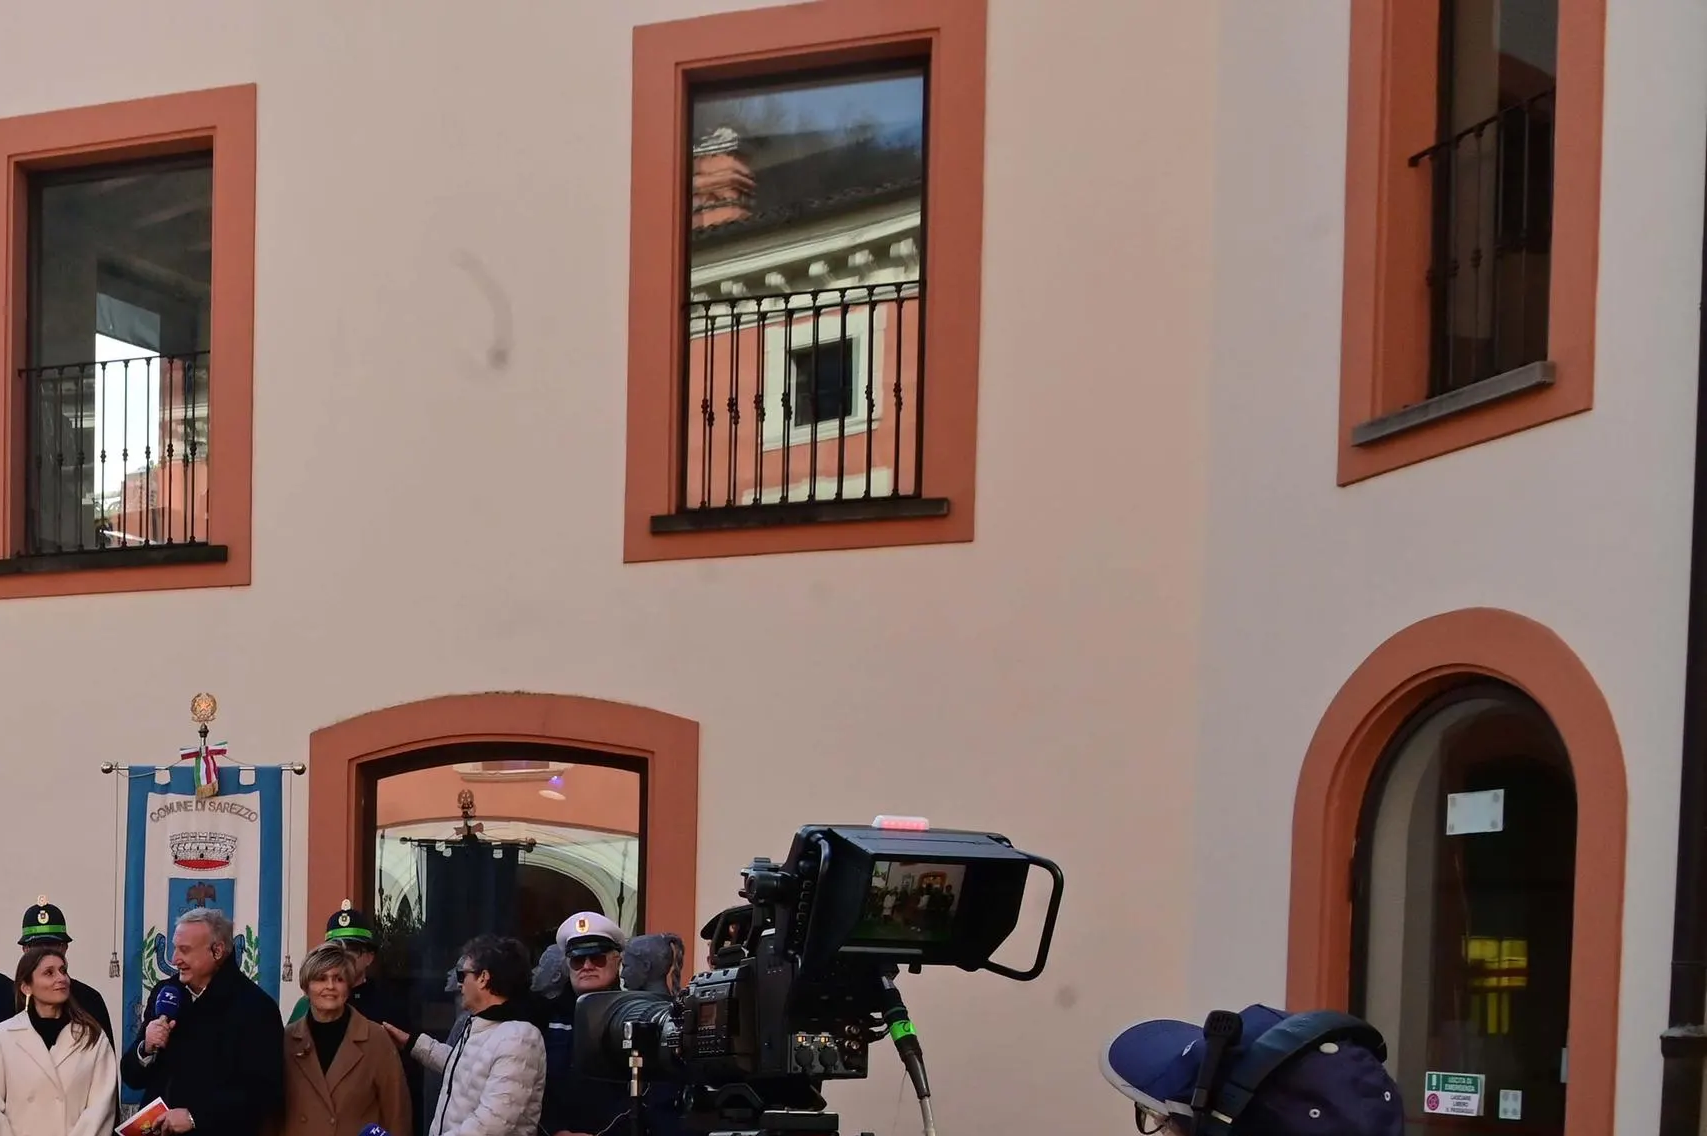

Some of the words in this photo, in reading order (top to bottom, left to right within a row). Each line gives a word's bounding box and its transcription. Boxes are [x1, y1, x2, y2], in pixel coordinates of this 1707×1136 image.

[150, 800, 193, 822] COMUNE
[195, 800, 205, 812] DI
[208, 801, 258, 822] SAREZZO
